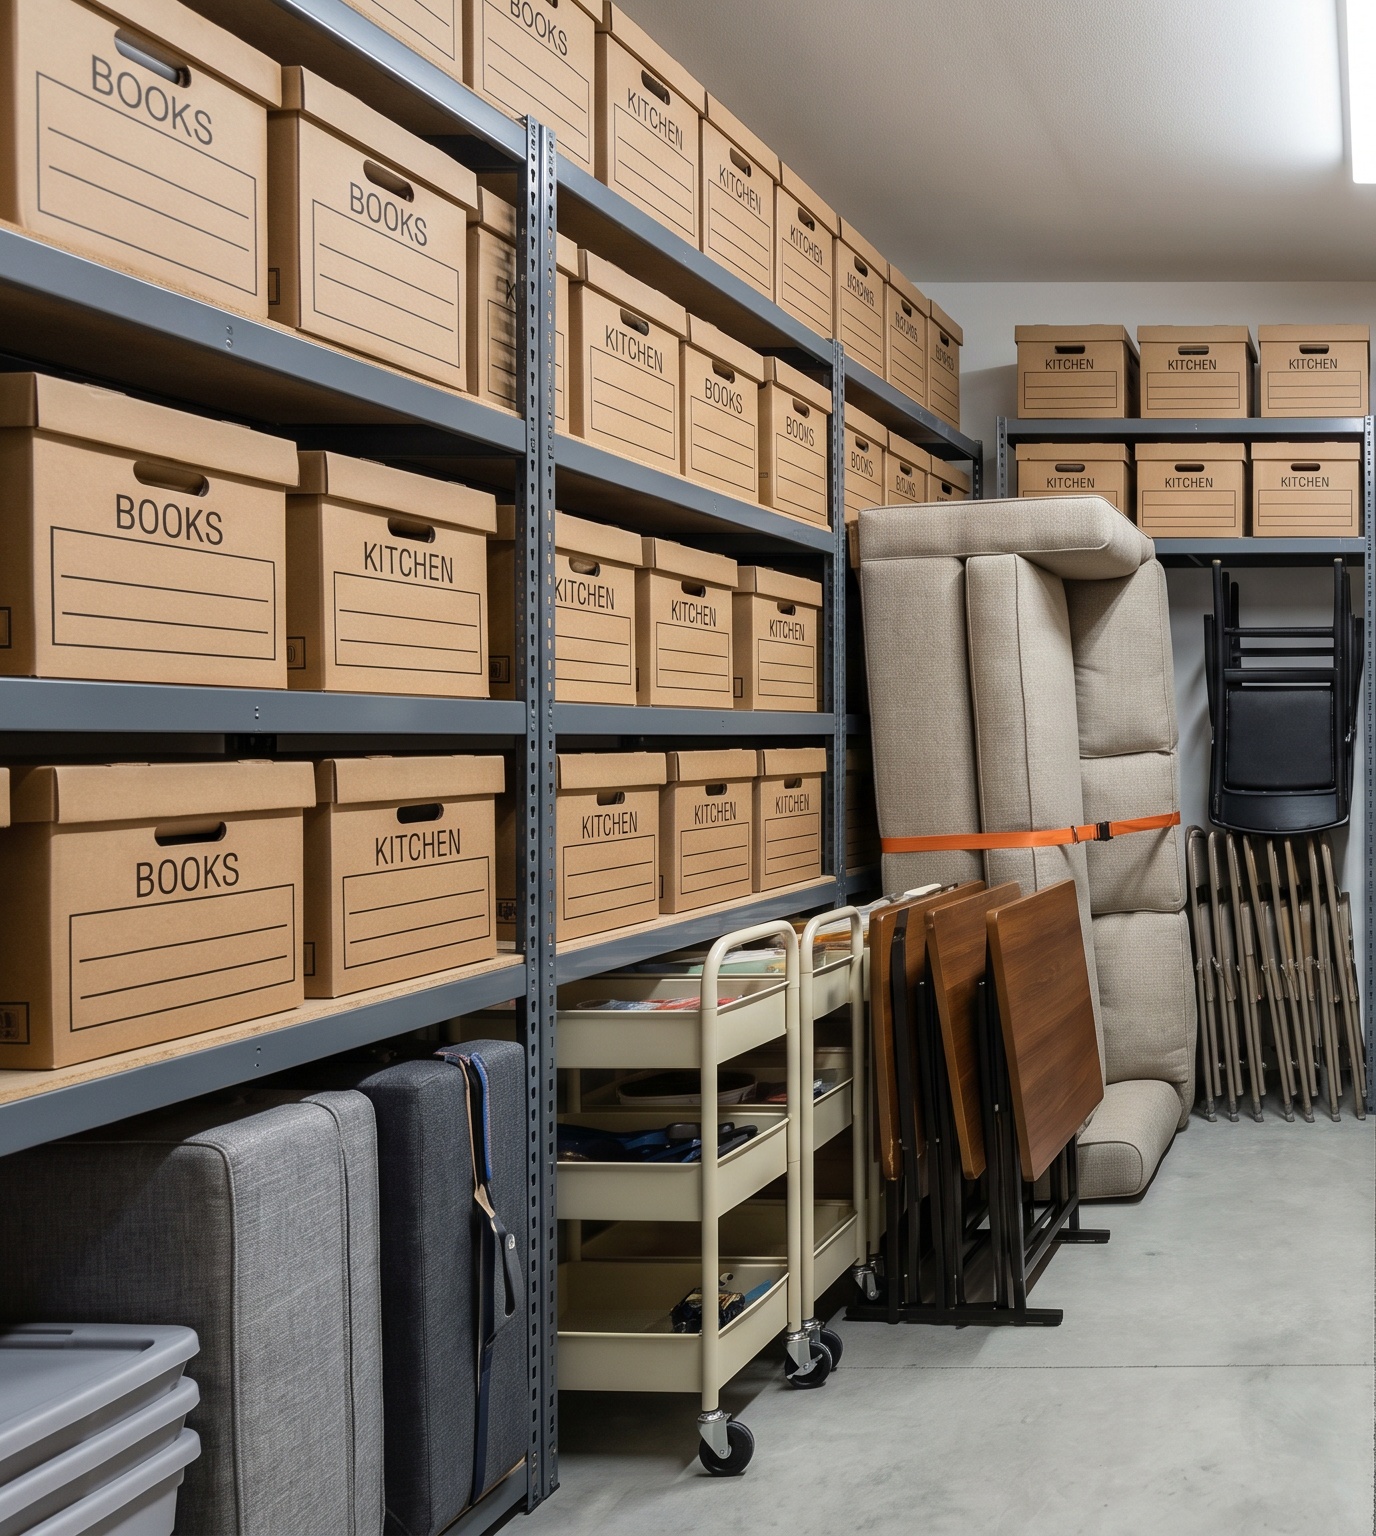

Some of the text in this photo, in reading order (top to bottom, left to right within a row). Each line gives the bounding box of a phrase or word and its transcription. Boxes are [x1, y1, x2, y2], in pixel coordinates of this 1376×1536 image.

[510, 0, 568, 56] BOOKS
[90, 55, 214, 146] BOOKS
[628, 87, 683, 151] KITCHEN
[719, 164, 761, 215] KITCHEN
[349, 182, 428, 247] BOOKS
[605, 324, 663, 374] KITCHEN
[1045, 358, 1094, 370] KITCHEN
[1168, 359, 1217, 371] KITCHEN
[1289, 358, 1337, 369] KITCHEN
[705, 378, 743, 415] BOOKS
[1047, 477, 1095, 488] KITCHEN
[1165, 477, 1213, 488] KITCHEN
[1281, 476, 1329, 488] KITCHEN
[115, 493, 224, 547] BOOKS
[363, 542, 453, 584] KITCHEN
[555, 576, 614, 610] KITCHEN
[671, 599, 717, 627] KITCHEN
[769, 619, 805, 642] KITCHEN
[694, 801, 737, 825] KITCHEN
[775, 794, 810, 815] KITCHEN
[582, 811, 638, 839] KITCHEN
[375, 828, 461, 866] KITCHEN
[135, 852, 240, 897] BOOKS
